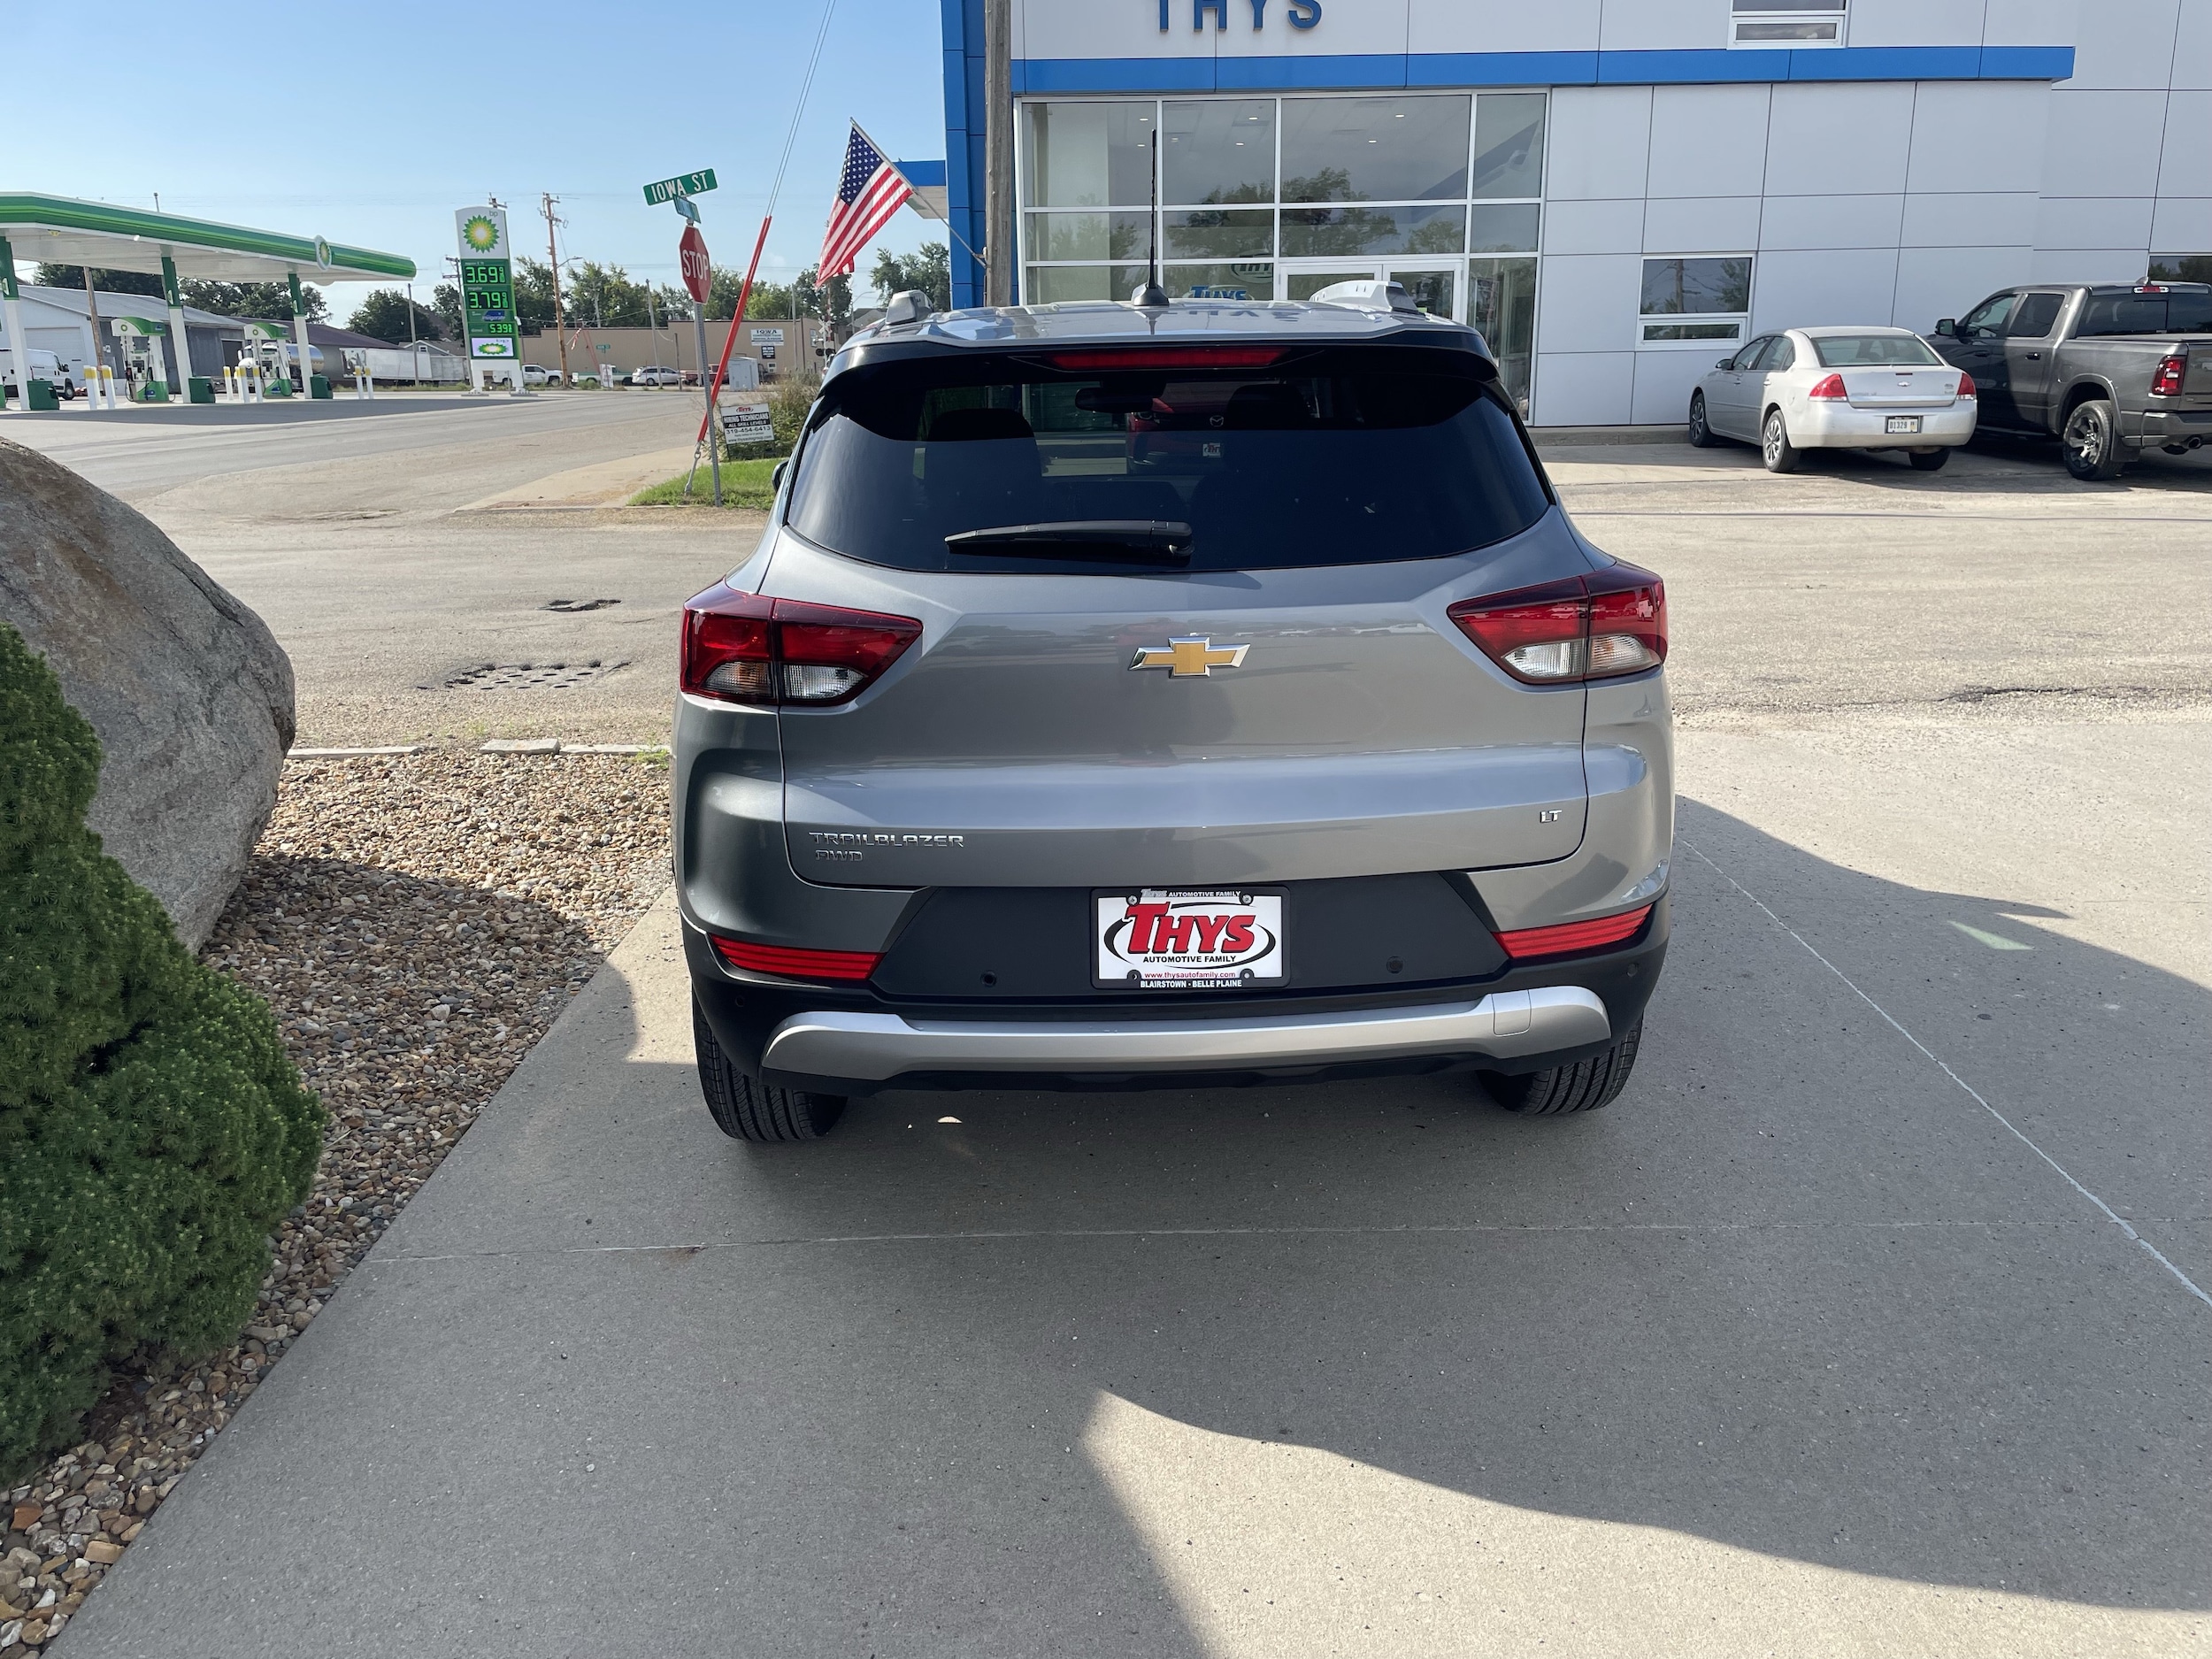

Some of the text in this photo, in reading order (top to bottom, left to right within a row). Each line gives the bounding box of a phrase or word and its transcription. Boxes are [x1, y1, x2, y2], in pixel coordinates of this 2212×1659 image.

[650, 173, 708, 203] IOWA ST
[682, 249, 709, 281] STOP
[740, 412, 769, 422] TECHNICIANS
[726, 426, 771, 434] 319-454-6413
[1540, 810, 1563, 823] LT
[809, 832, 964, 848] TRAILBLAZER
[815, 849, 864, 862] AWD
[1124, 901, 1256, 954] THYS
[1140, 979, 1187, 988] BLAIRSTOWN
